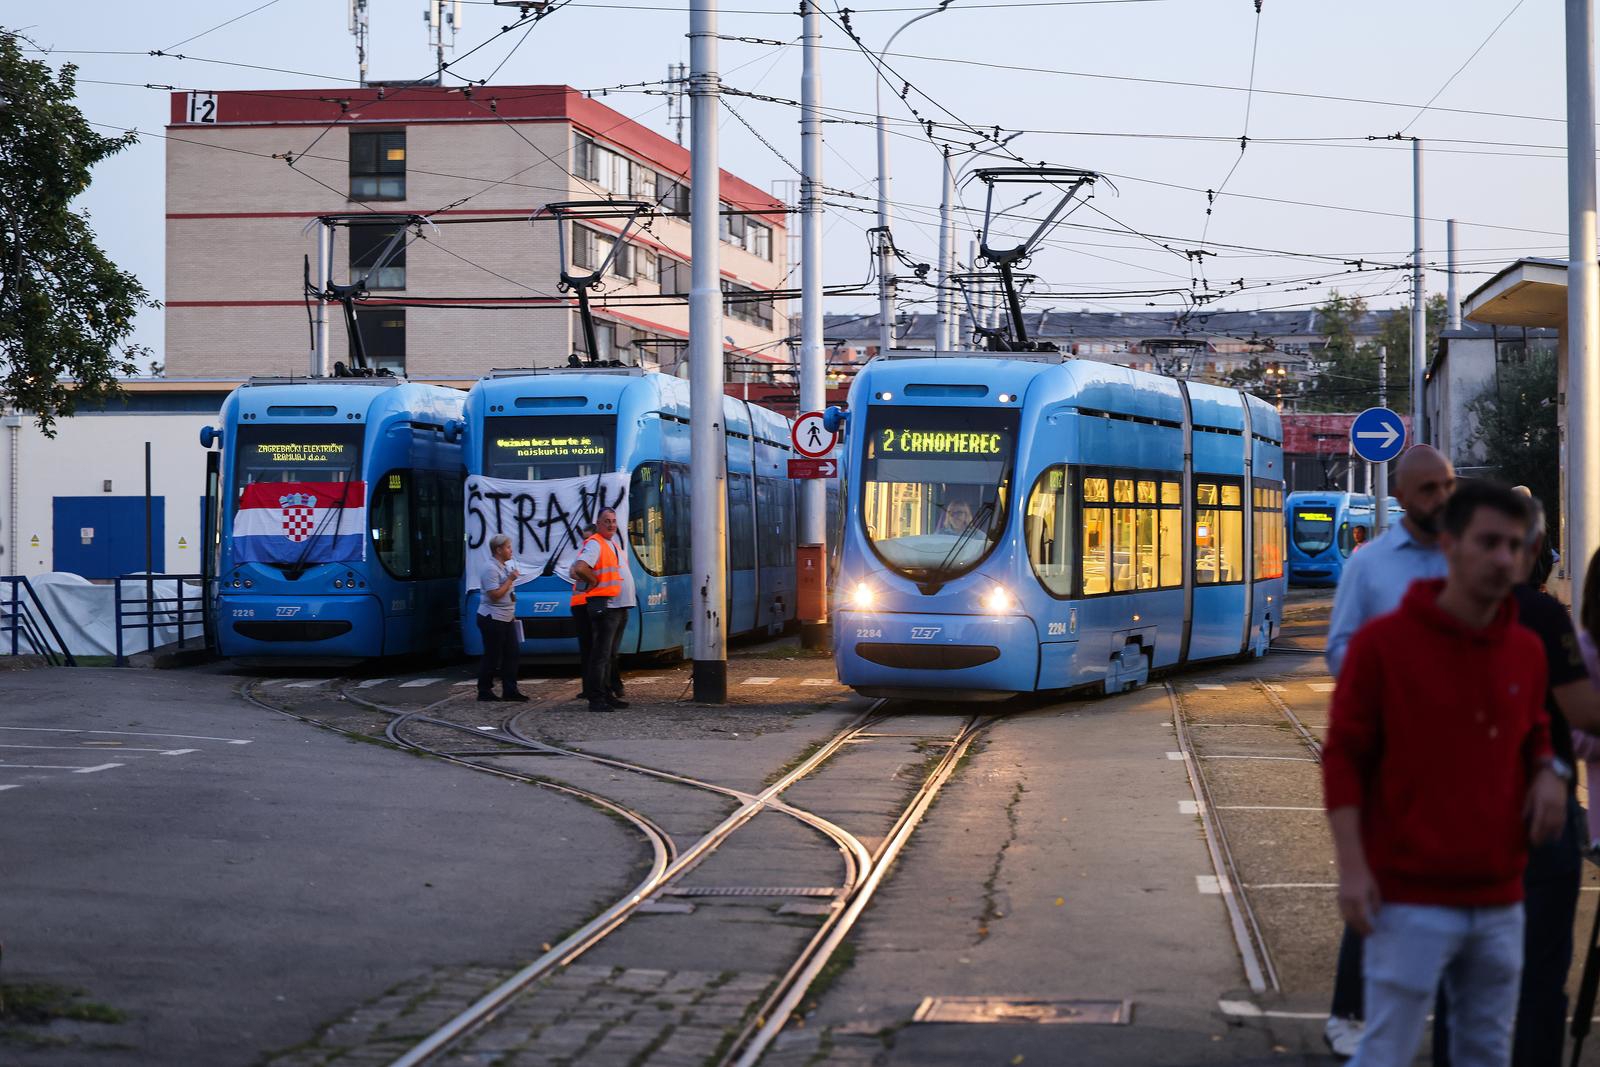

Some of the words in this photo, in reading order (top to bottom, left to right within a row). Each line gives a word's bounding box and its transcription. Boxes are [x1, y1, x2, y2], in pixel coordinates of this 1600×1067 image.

[883, 428, 894, 452] 2
[900, 429, 1001, 453] ČRNOMEREC
[257, 443, 302, 453] ZAGREBAČKI
[303, 443, 344, 453] ELEKTRIČNI
[517, 447, 568, 457] najskuplja
[571, 446, 604, 455] vožnja
[275, 606, 302, 617] ZET
[533, 601, 559, 613] ZET
[232, 609, 256, 617] 2226
[856, 628, 882, 638] 2284
[911, 626, 942, 639] ZET
